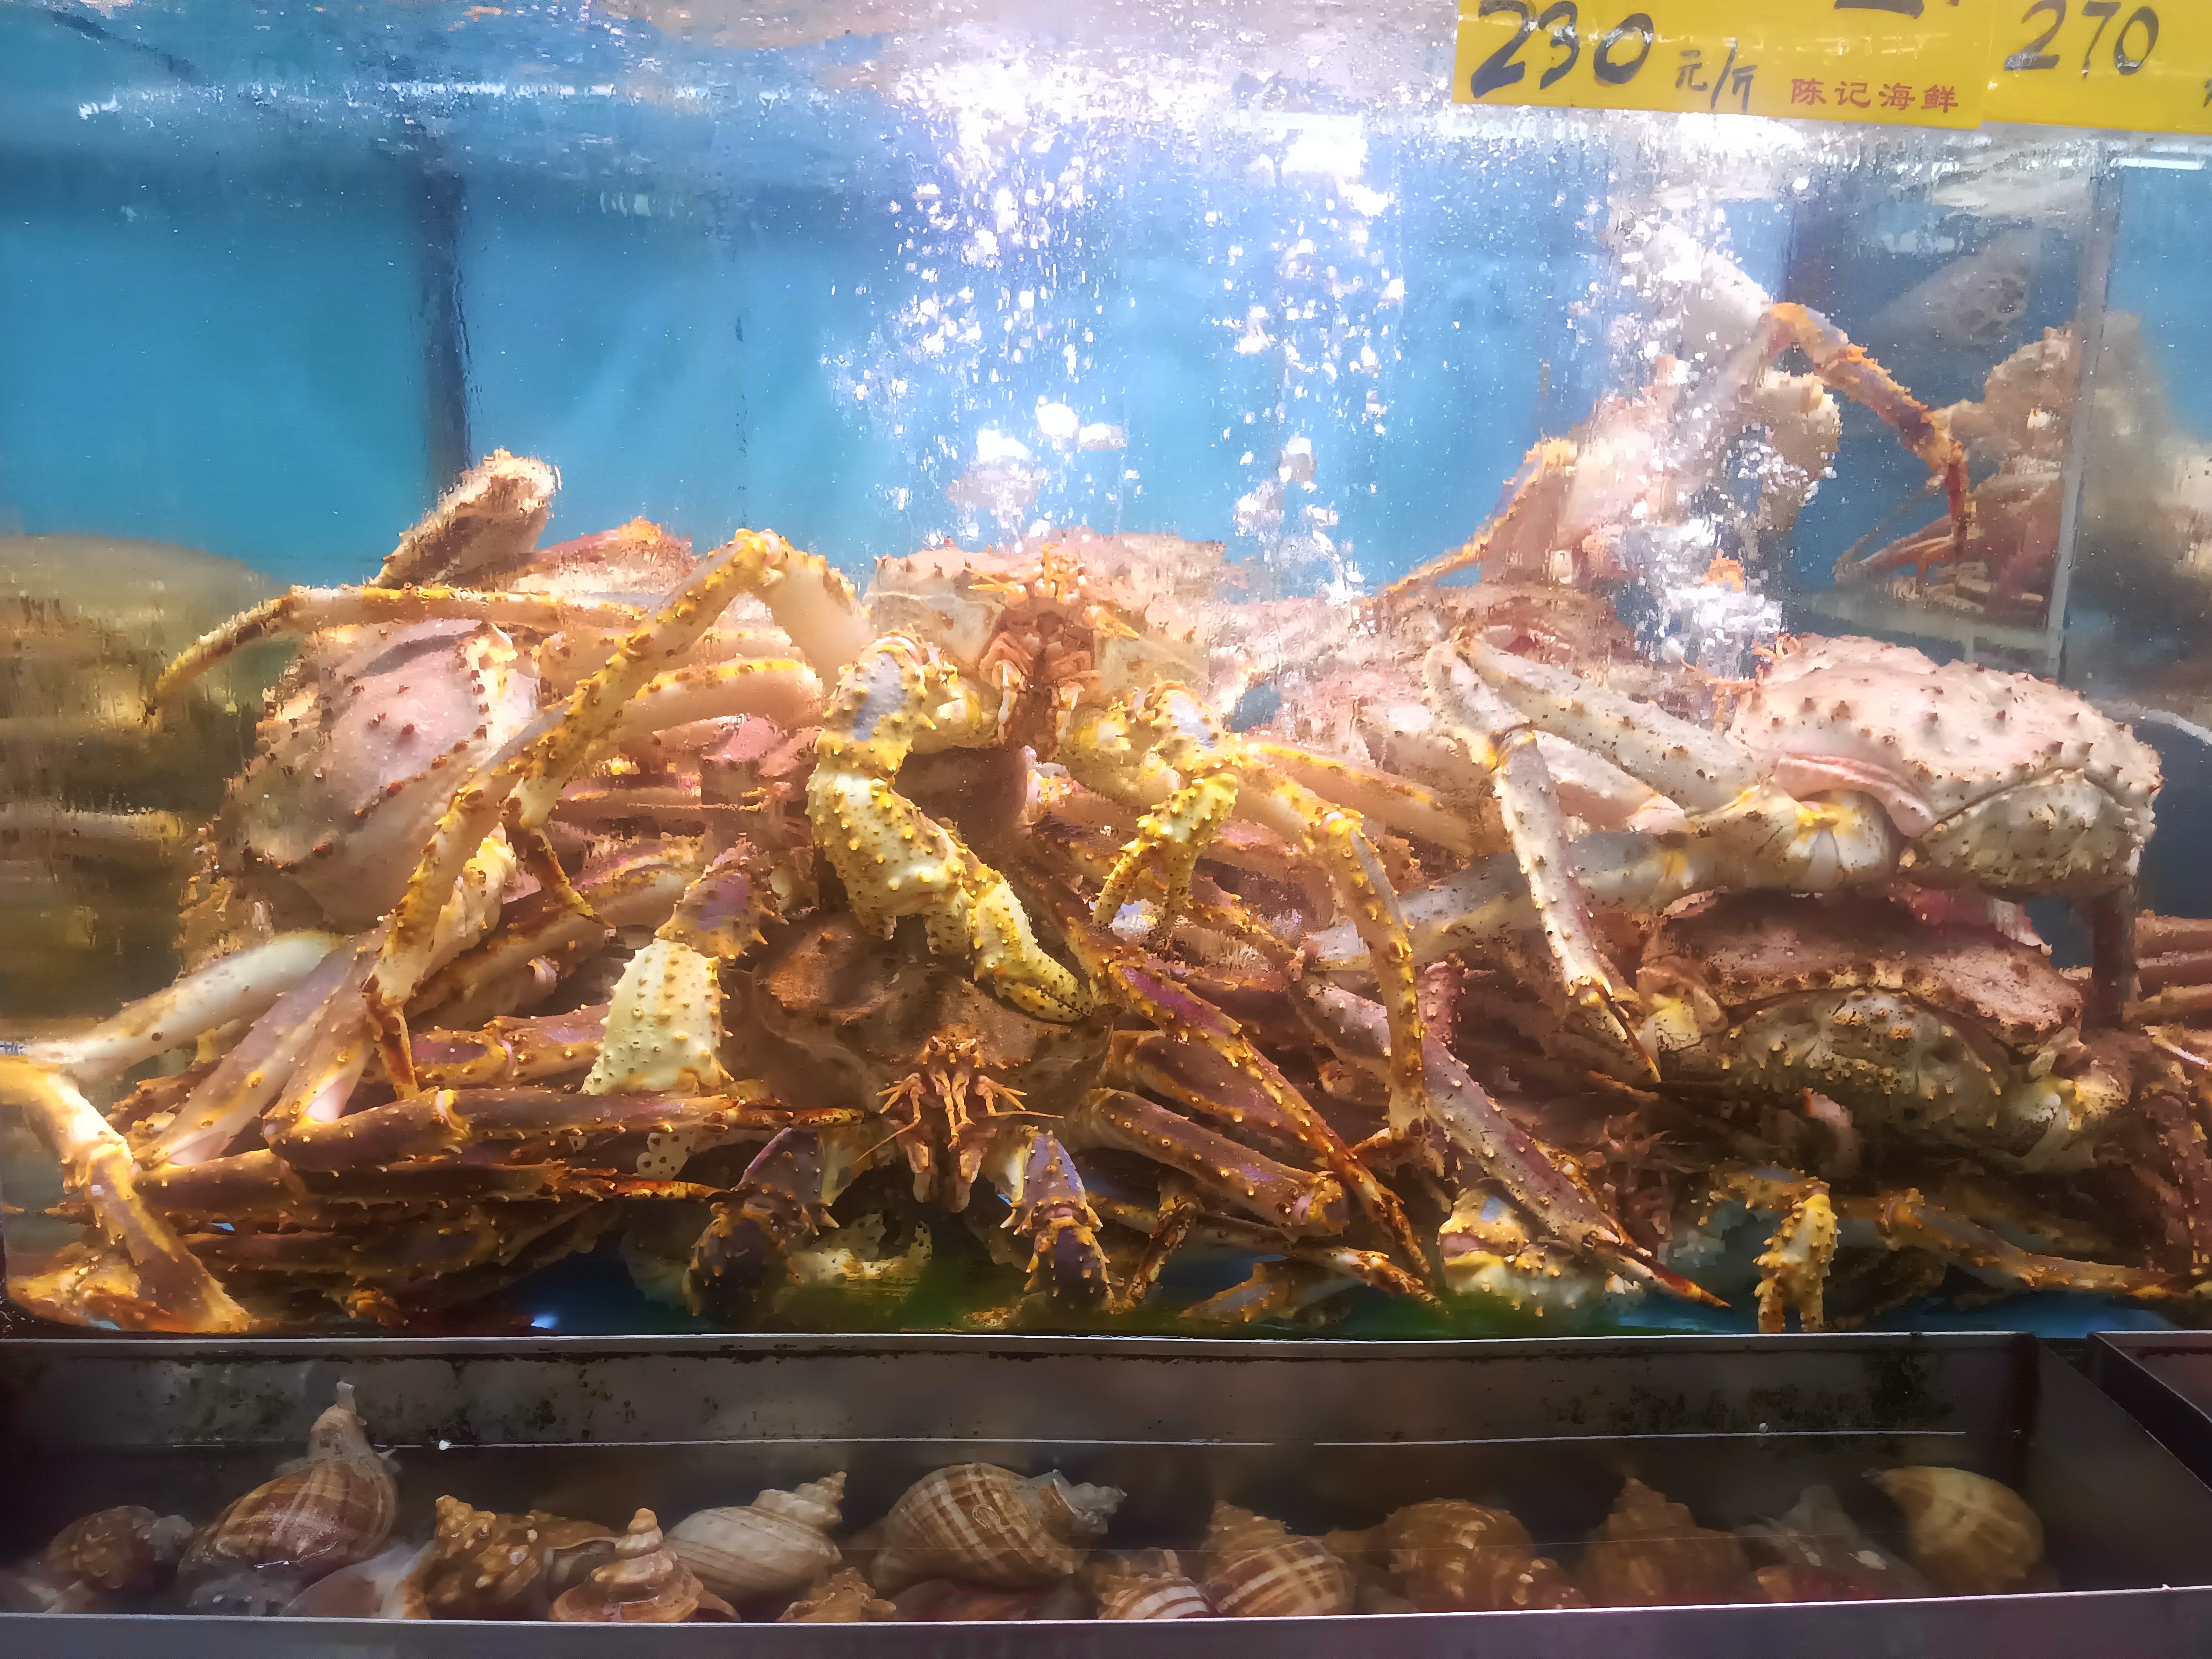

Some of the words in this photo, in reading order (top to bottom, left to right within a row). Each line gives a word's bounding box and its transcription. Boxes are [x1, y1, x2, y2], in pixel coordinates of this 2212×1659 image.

[1471, 0, 1654, 98] 230
[2004, 0, 2159, 78] 270
[1791, 78, 1958, 113] 陈记海鲜
